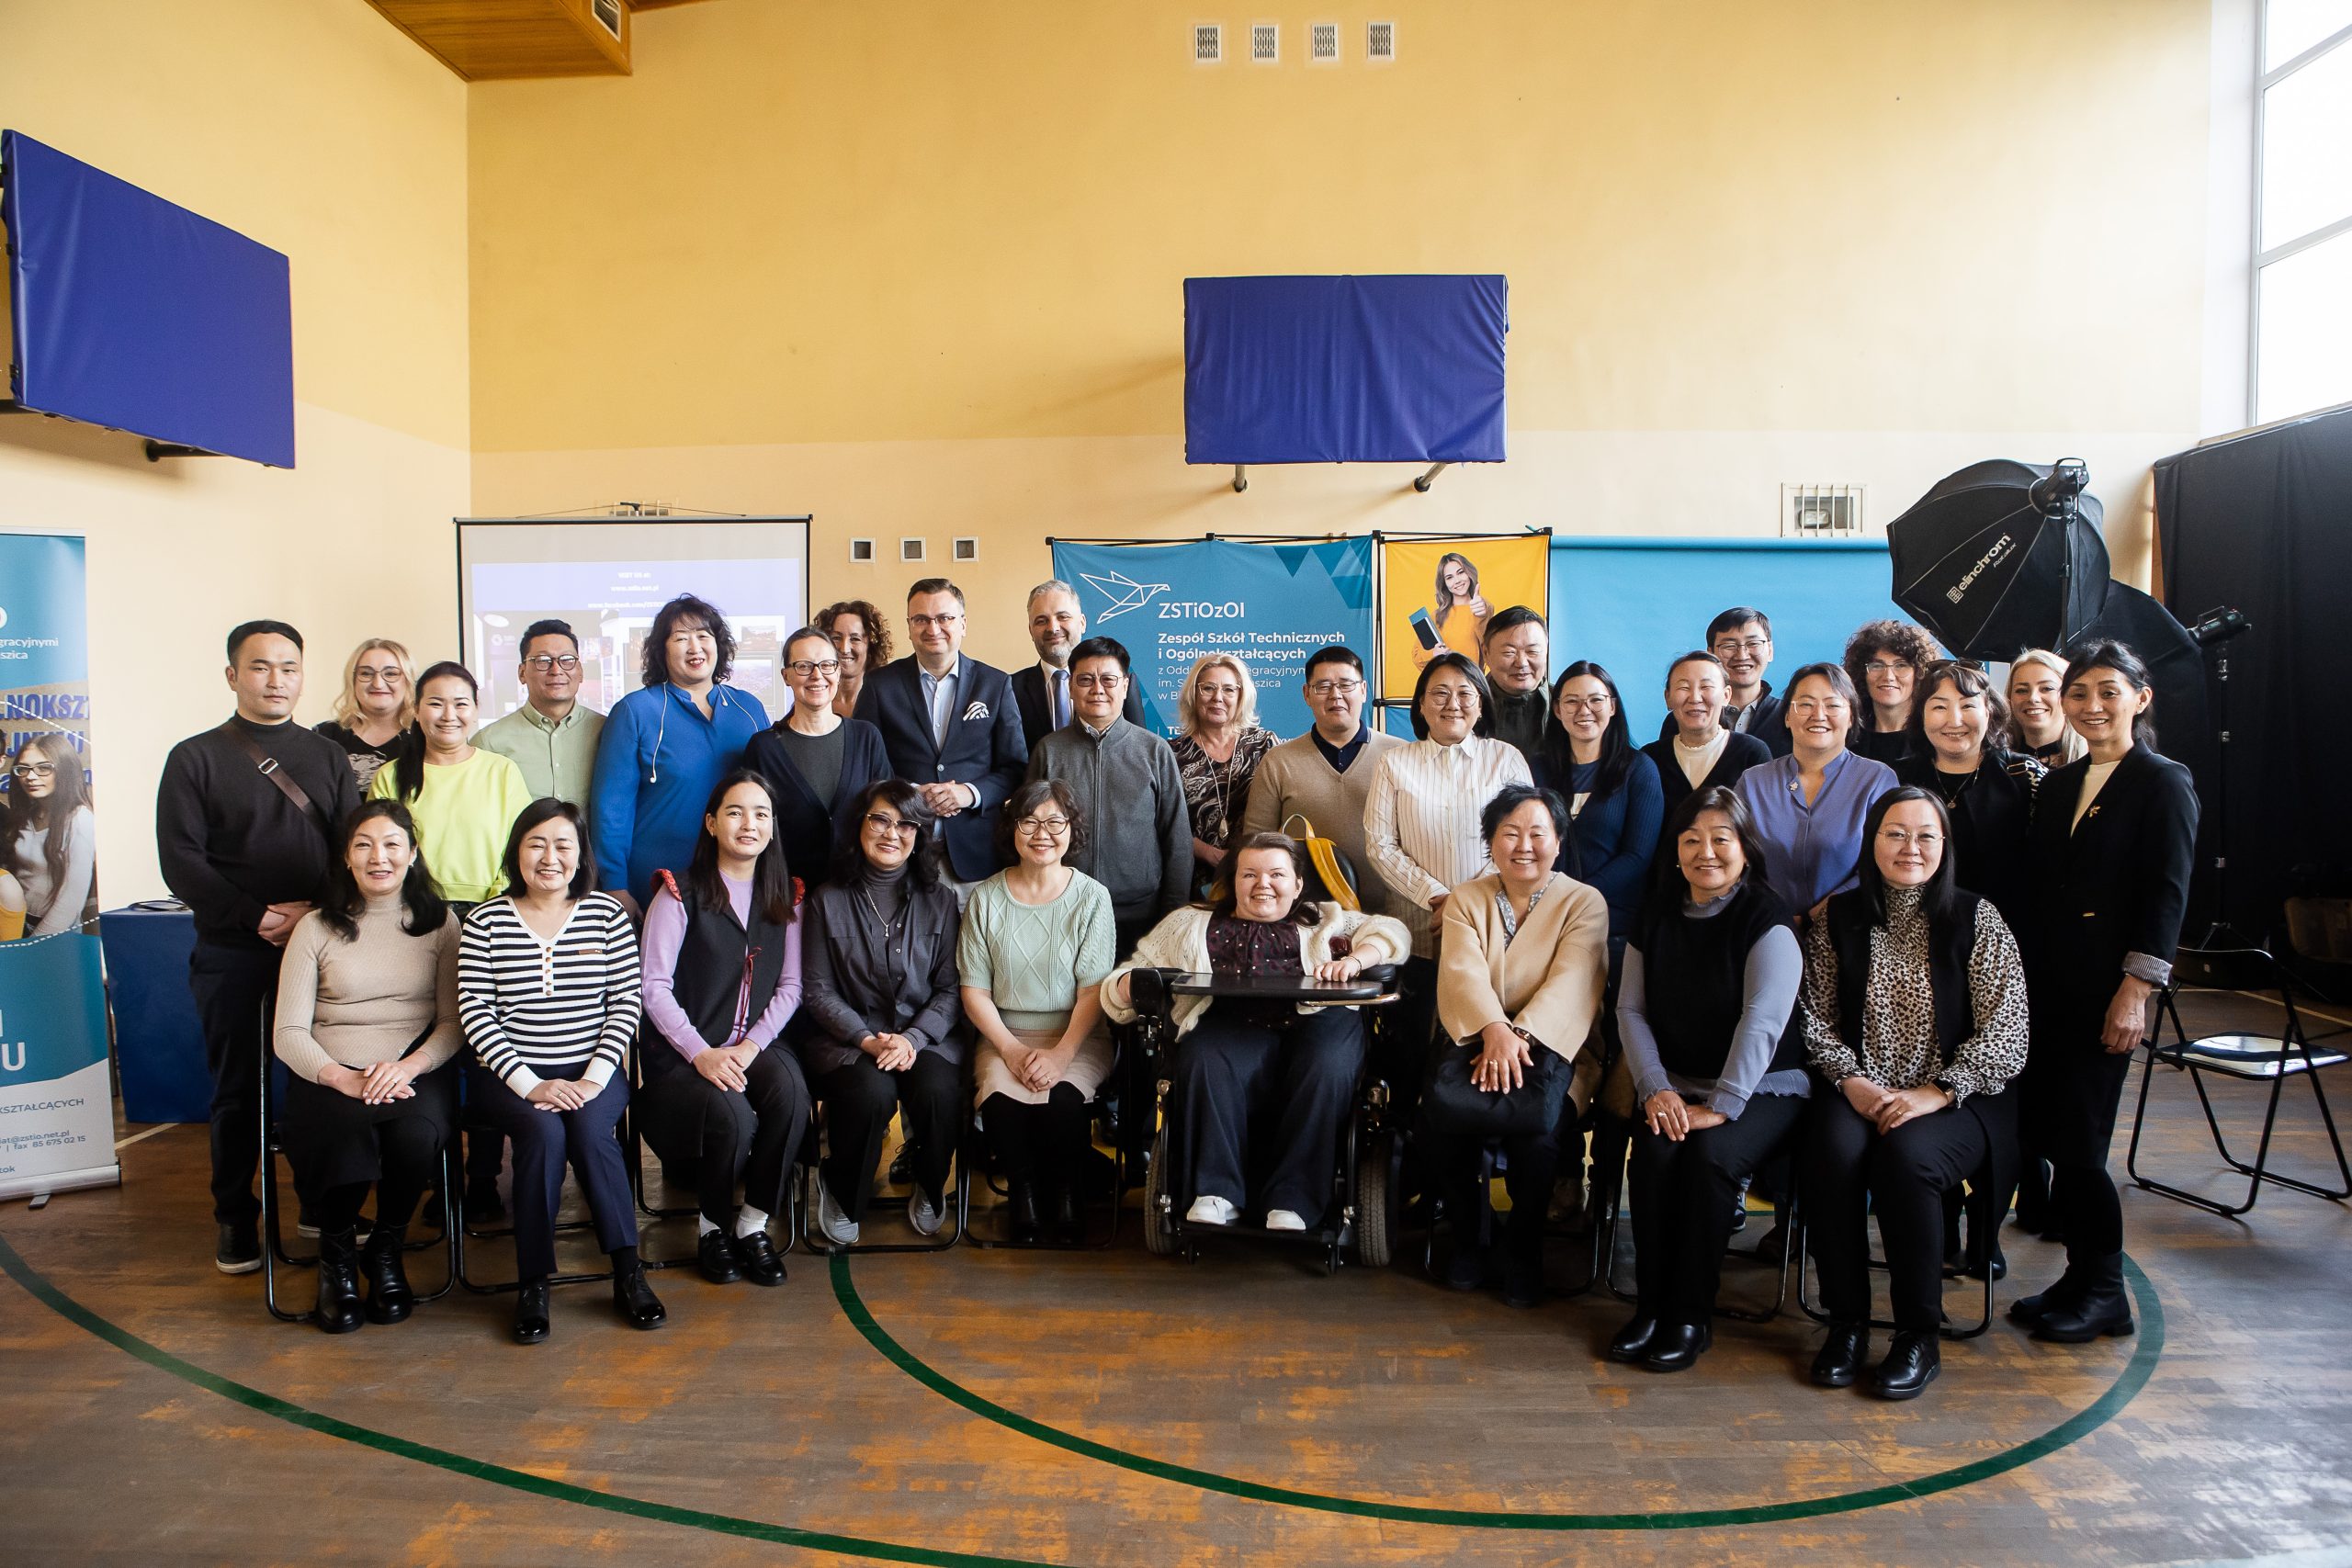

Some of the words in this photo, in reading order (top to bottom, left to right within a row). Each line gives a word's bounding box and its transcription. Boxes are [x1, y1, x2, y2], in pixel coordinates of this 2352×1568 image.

[1958, 534, 2011, 591] elinchrom
[1158, 632, 1204, 646] Zespół
[1207, 631, 1245, 644] Szkół
[1249, 631, 1345, 646] Technicznych
[1158, 648, 1162, 660] i
[1158, 667, 1164, 675] z
[1158, 678, 1175, 688] im.
[1254, 678, 1281, 688] szica
[0, 693, 89, 720] NOKSZ
[0, 1130, 69, 1145] at@zstio.net.pl
[14, 1142, 28, 1150] fax
[46, 1138, 62, 1146] 675
[64, 1136, 74, 1145] 02
